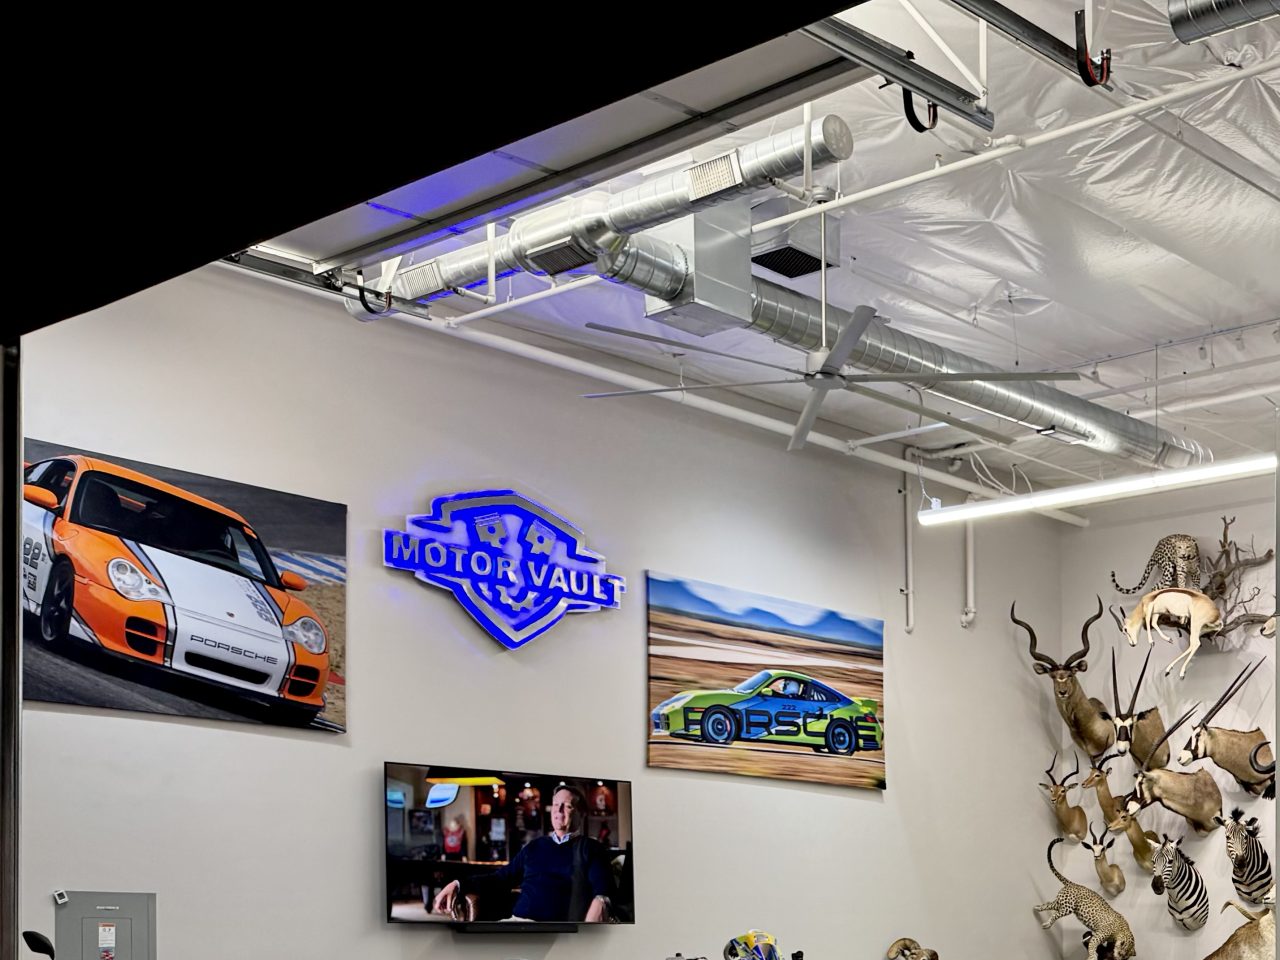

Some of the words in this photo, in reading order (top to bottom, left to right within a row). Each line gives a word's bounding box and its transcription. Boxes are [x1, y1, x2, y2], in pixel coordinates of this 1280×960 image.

[391, 534, 517, 584] MOTOR
[527, 561, 626, 608] VAULT
[190, 634, 279, 665] PORSCHE
